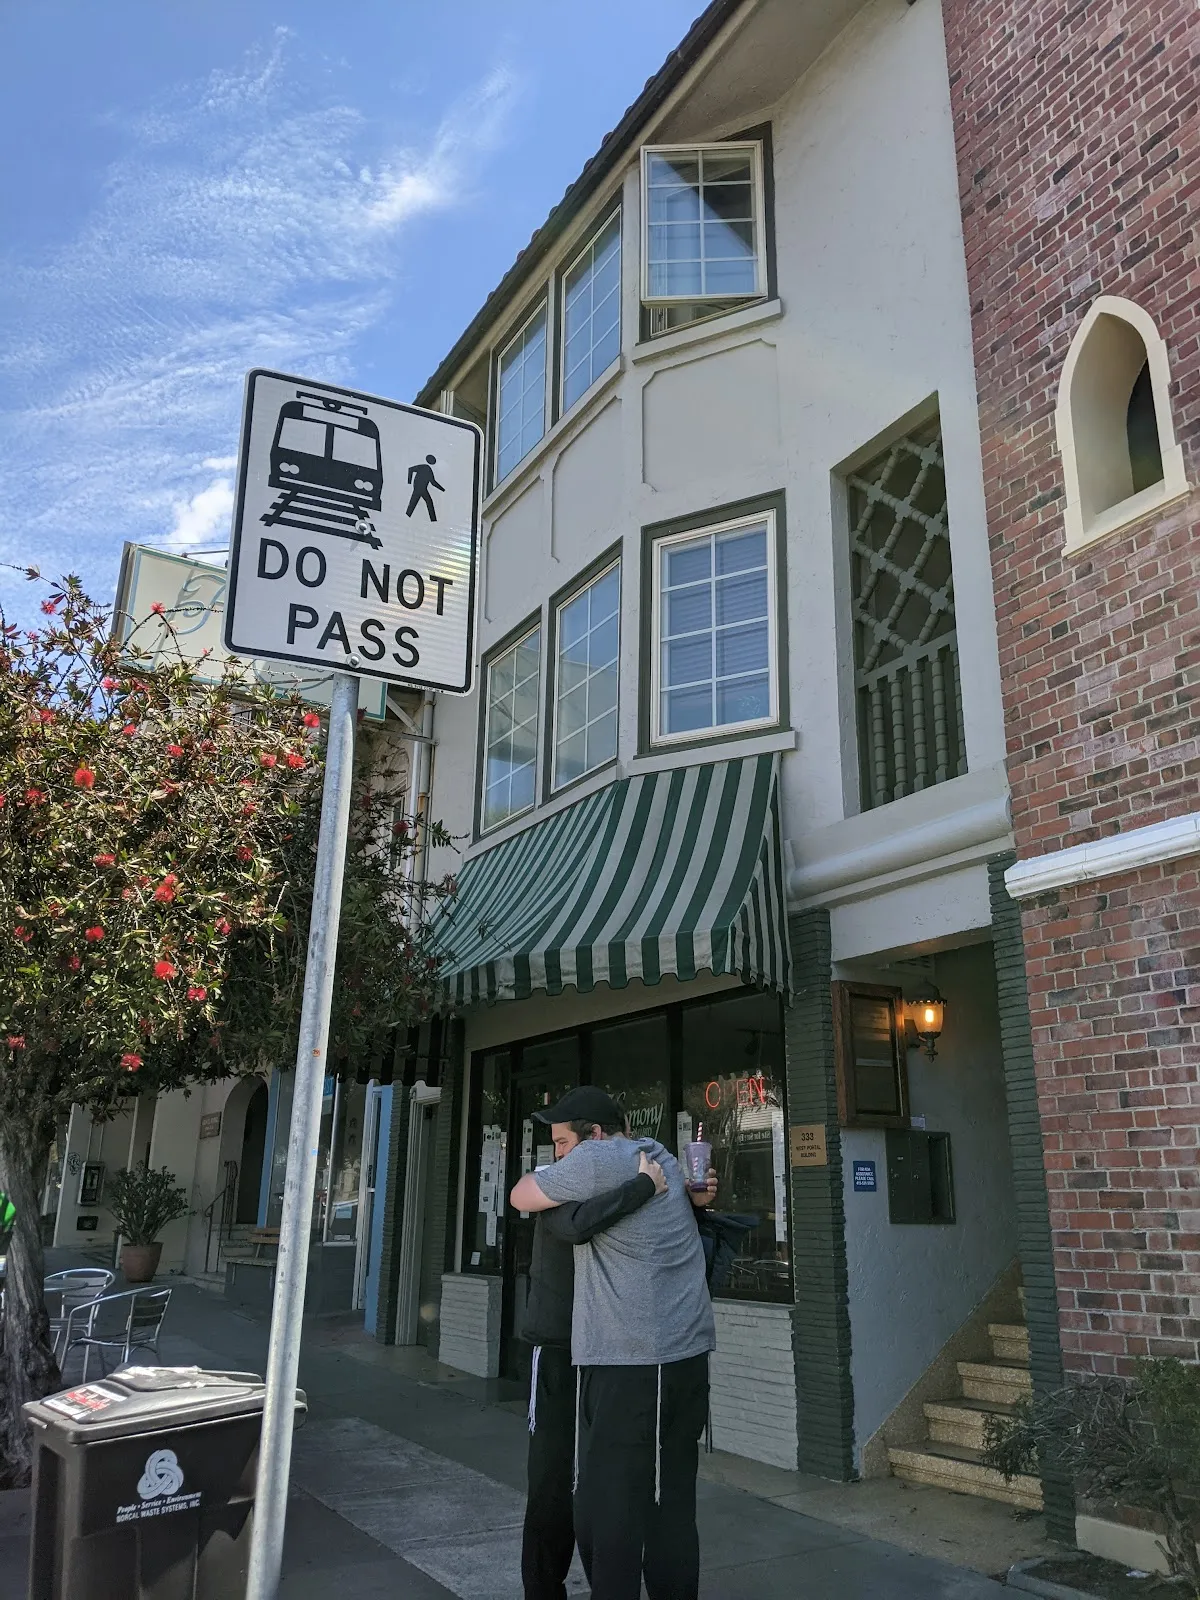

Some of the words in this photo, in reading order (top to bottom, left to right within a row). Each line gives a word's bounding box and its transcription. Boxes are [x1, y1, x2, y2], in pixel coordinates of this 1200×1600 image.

[257, 537, 327, 588] DO
[360, 559, 453, 616] NOT
[286, 603, 420, 668] PASS
[802, 1133, 815, 1142] 333
[141, 1508, 160, 1517] WASTE
